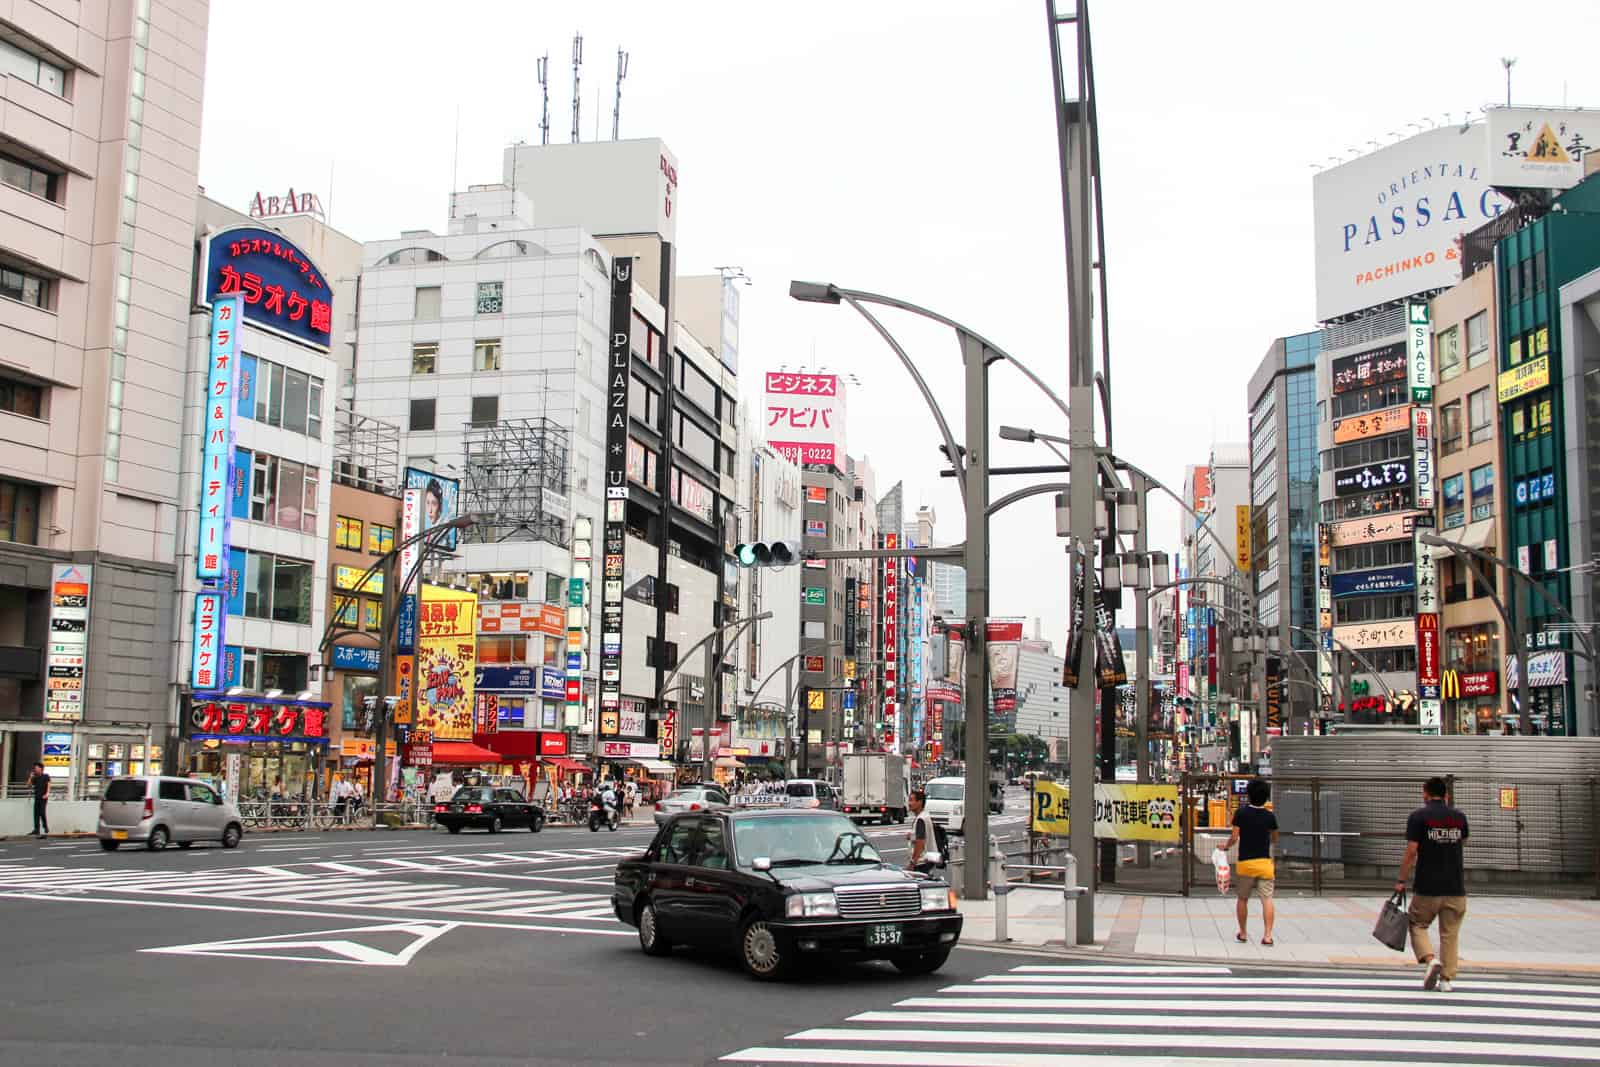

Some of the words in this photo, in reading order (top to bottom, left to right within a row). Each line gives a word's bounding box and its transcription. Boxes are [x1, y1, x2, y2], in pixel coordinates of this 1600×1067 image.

[1377, 163, 1479, 204] ORIENTAL
[251, 187, 313, 217] ABAB
[1356, 251, 1436, 285] PACHINKO
[219, 265, 332, 334] カラオケ館
[1415, 327, 1427, 384] SPACE
[611, 333, 627, 428] PLAZA
[768, 375, 834, 393] ビジネス
[1415, 390, 1429, 399] 7F
[767, 406, 833, 429] アビバ
[1418, 554, 1436, 607] 黒船亭
[197, 597, 215, 686] カラオケ館
[201, 702, 325, 737] カラオケ館
[1037, 791, 1052, 821] P
[1094, 799, 1148, 825] り地下駐車場
